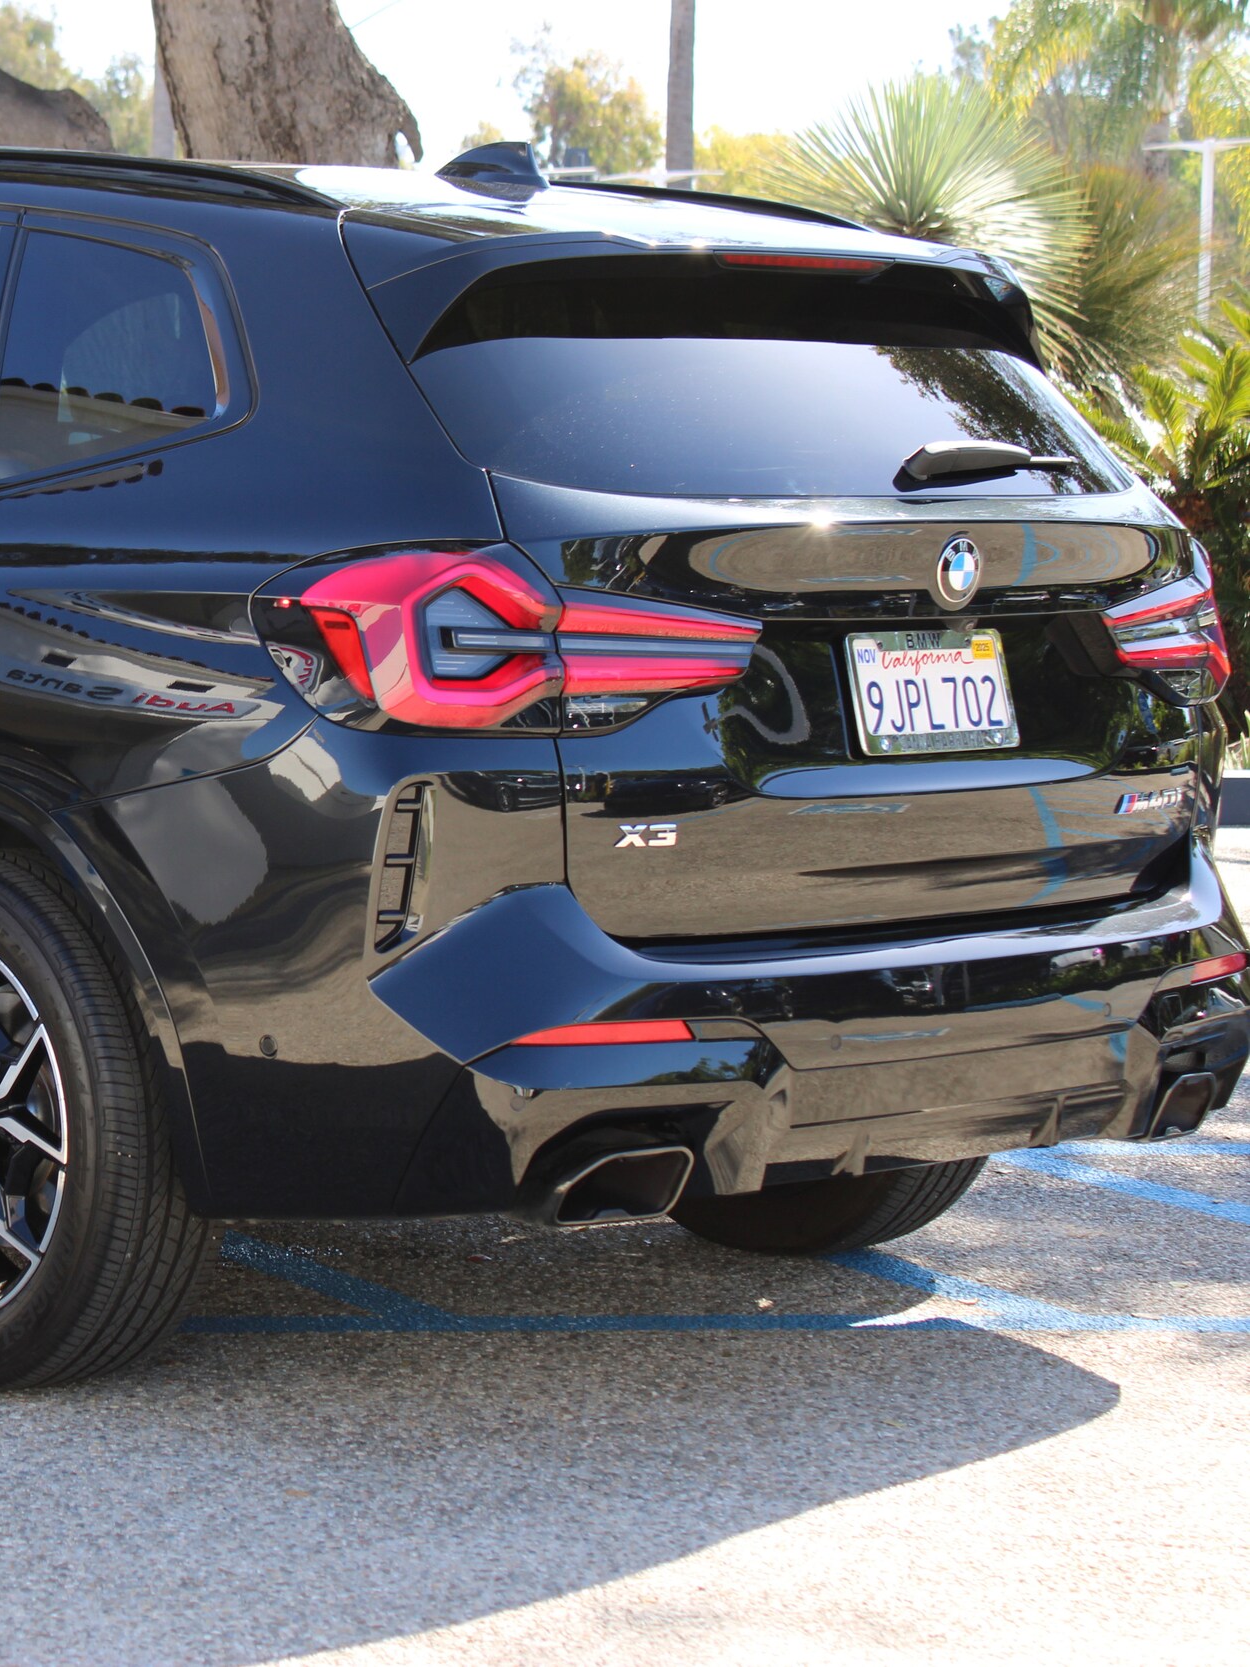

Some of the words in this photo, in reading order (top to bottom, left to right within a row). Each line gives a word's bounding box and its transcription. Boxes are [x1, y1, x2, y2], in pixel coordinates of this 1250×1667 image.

[905, 632, 941, 649] BMW
[857, 648, 876, 664] NOV
[881, 651, 974, 676] California
[866, 675, 1004, 735] 9JPL702
[614, 823, 677, 848] X3
